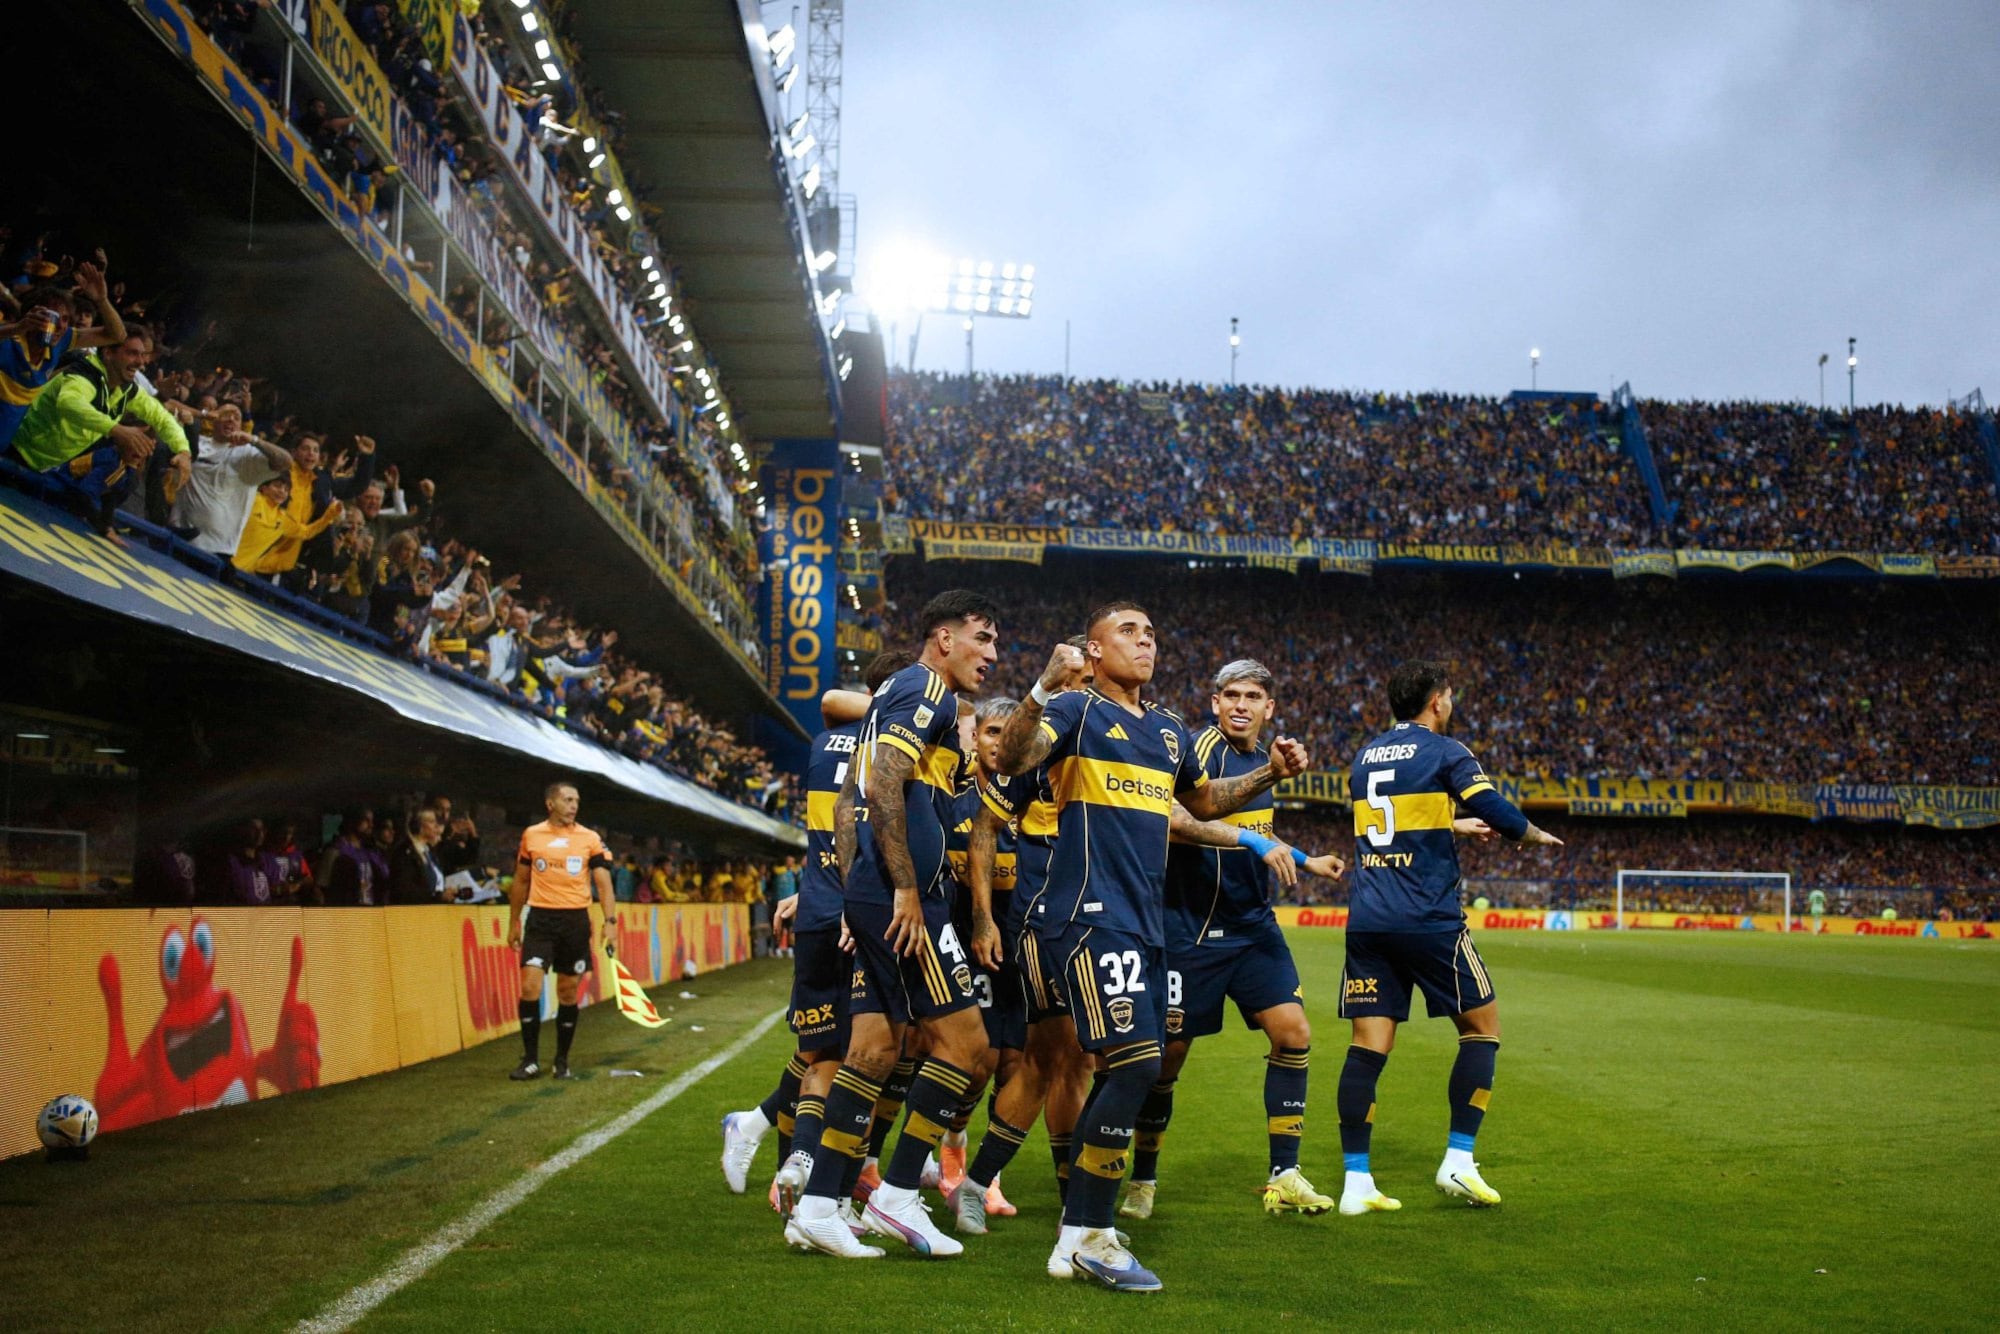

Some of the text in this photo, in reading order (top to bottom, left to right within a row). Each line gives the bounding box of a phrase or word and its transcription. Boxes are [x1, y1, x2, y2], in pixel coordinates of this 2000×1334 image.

[774, 494, 790, 530] sitio
[911, 520, 979, 541] VIVA
[981, 525, 1063, 545] BOCA
[1073, 528, 1189, 549] ENSENADA
[774, 533, 789, 556] de
[1192, 533, 1294, 556] LOS HORNOS
[1311, 538, 1378, 559] DERQUI
[787, 468, 834, 700] betsson
[770, 562, 788, 640] puestas
[1361, 744, 1418, 765] PAREDES
[1815, 785, 1897, 800] VICTORIA
[1366, 768, 1396, 847] 5
[1837, 801, 1901, 819] DIAMANTE
[1484, 911, 1568, 930] Quini 6
[1922, 920, 1940, 938] 6
[1099, 949, 1146, 996] 32
[1346, 977, 1378, 997] pax
[795, 1003, 836, 1028] pax
